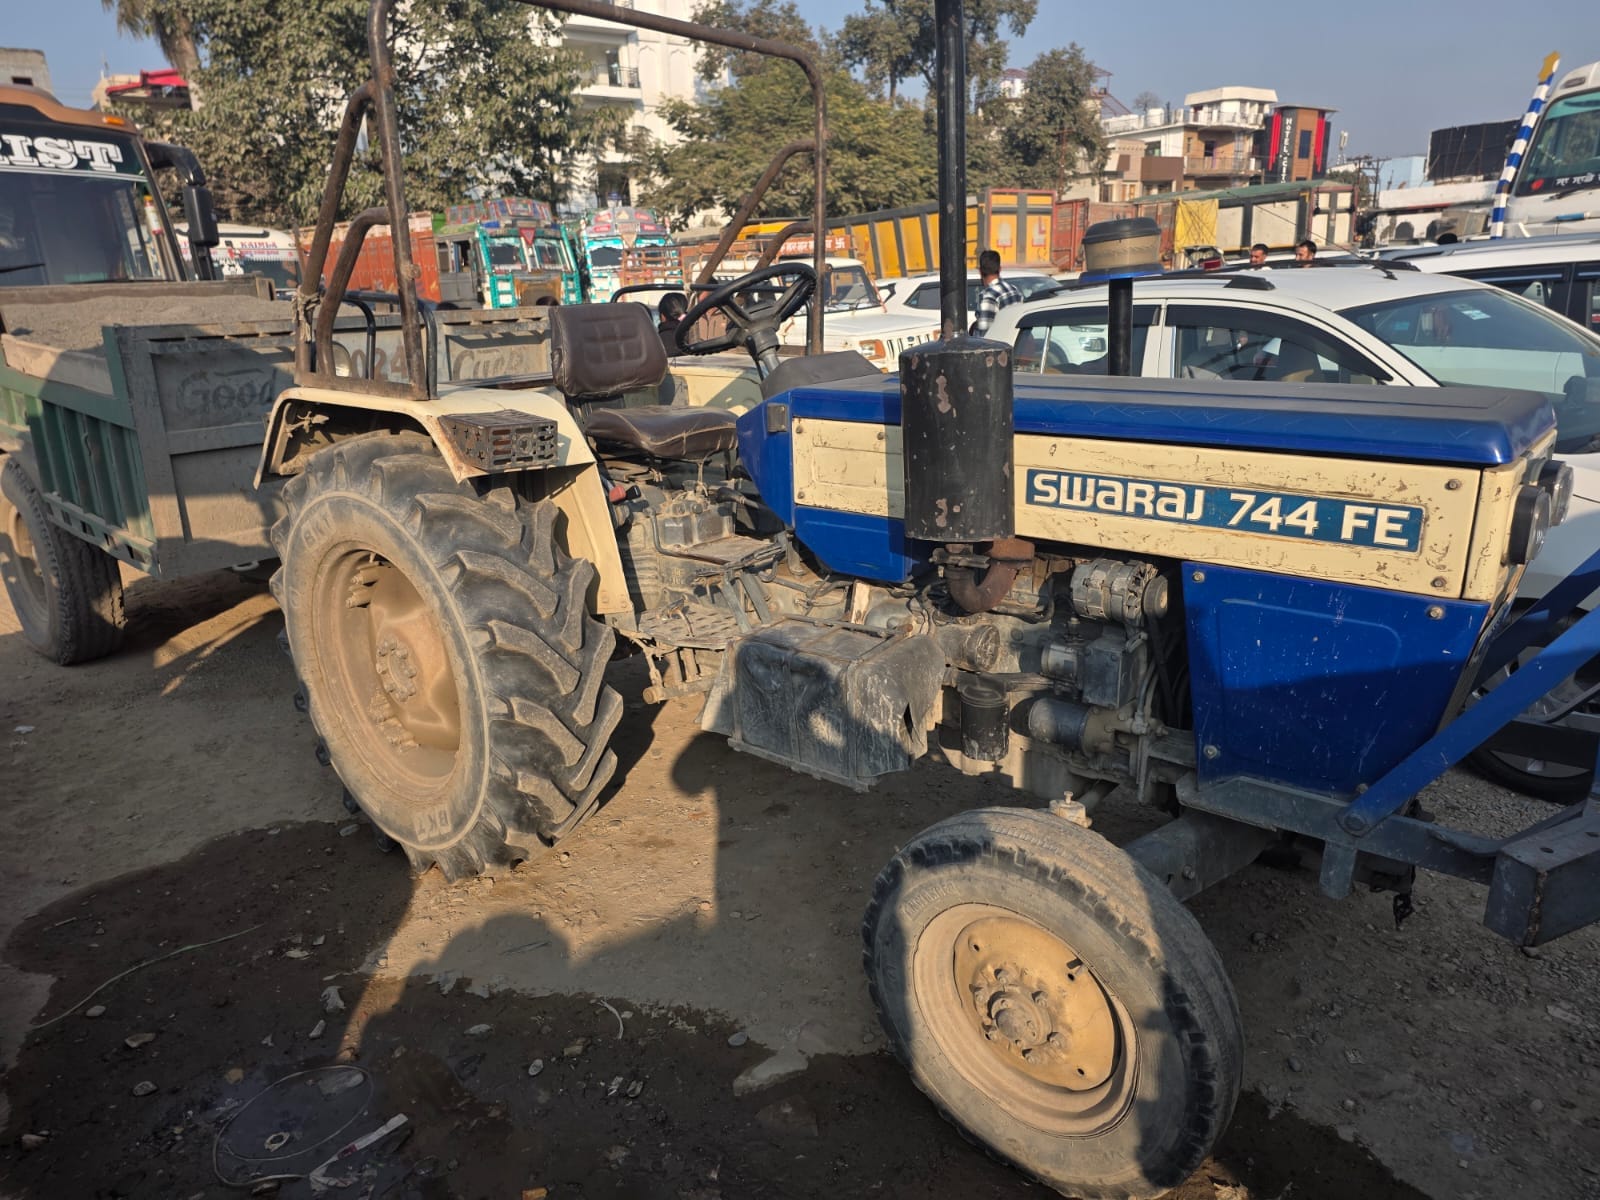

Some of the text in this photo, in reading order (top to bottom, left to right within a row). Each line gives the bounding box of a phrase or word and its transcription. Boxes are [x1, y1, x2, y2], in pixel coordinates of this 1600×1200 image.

[1283, 117, 1293, 153] HOTEL
[1227, 492, 1319, 536] 744
[1340, 505, 1411, 547] FE
